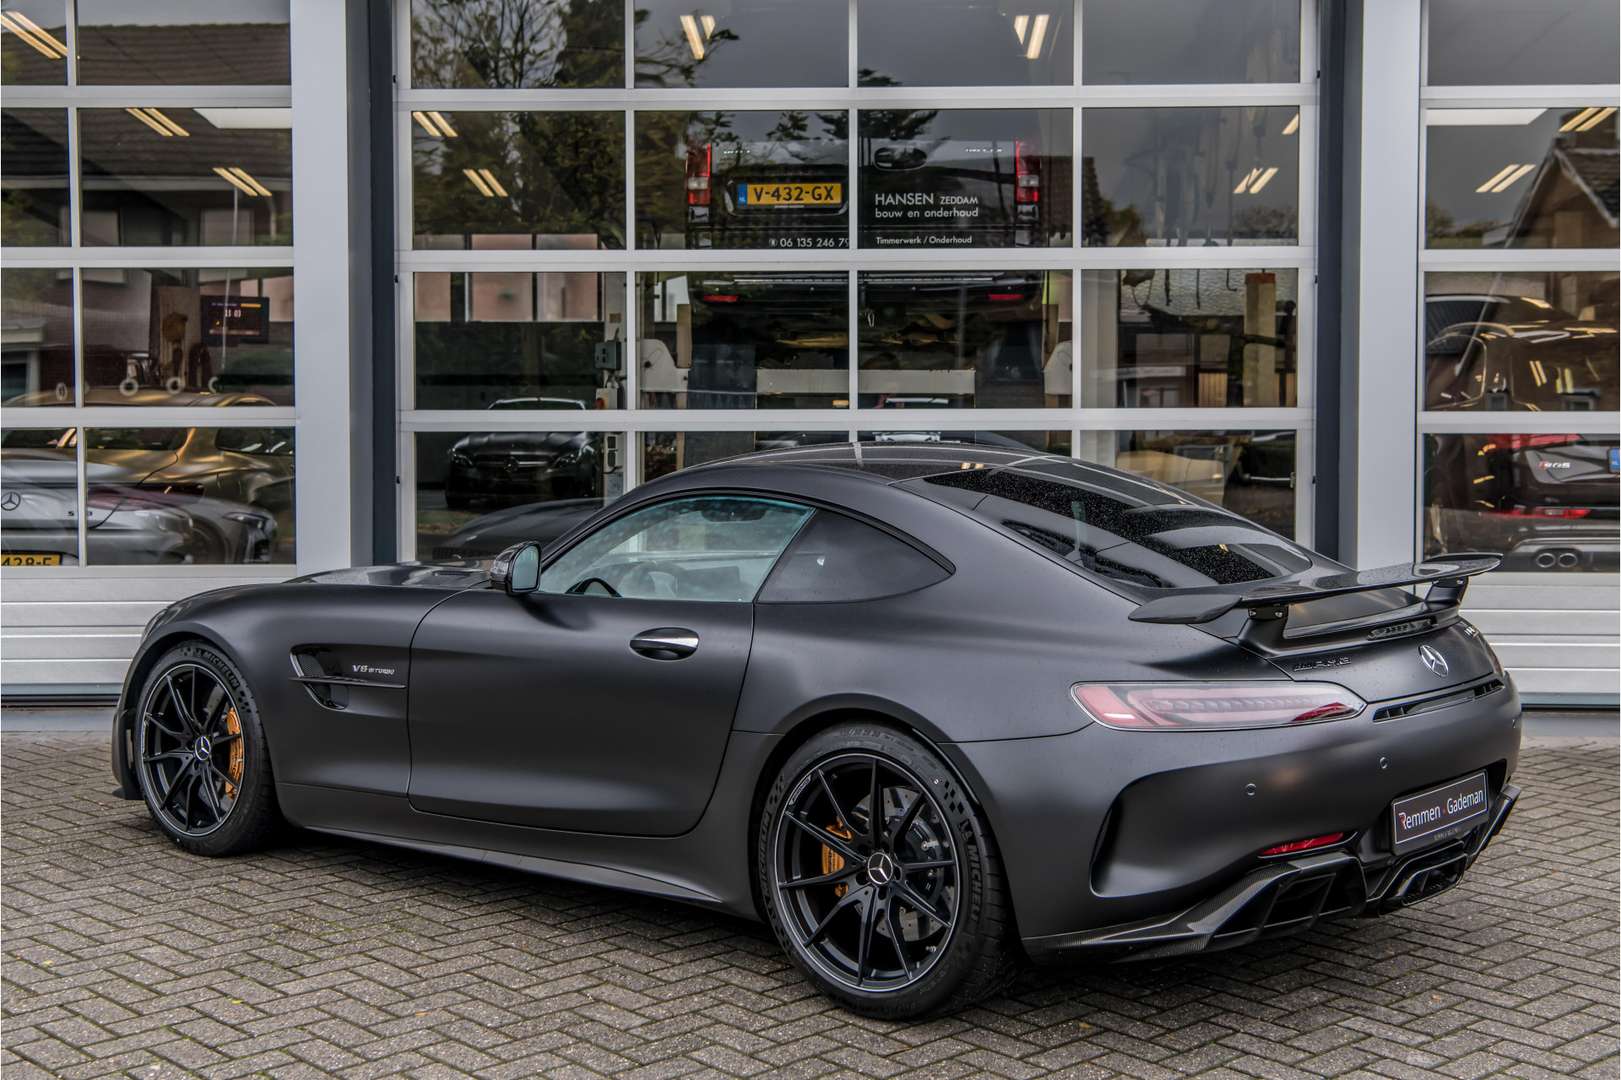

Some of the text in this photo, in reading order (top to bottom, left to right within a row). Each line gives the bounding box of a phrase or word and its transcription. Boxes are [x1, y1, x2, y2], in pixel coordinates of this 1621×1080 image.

[754, 186, 834, 201] V-432-GX
[875, 193, 978, 205] HANSEN ZEDDAM
[875, 207, 979, 218] bouw en onderhoud
[780, 238, 793, 248] 06
[798, 238, 812, 248] 135
[816, 238, 835, 248] 246
[876, 236, 921, 245] Timmerwerk
[928, 235, 972, 245] Onderhoud
[203, 650, 241, 689] MICHELIN
[352, 664, 368, 673] V8
[1399, 789, 1484, 831] Remmen Gademan
